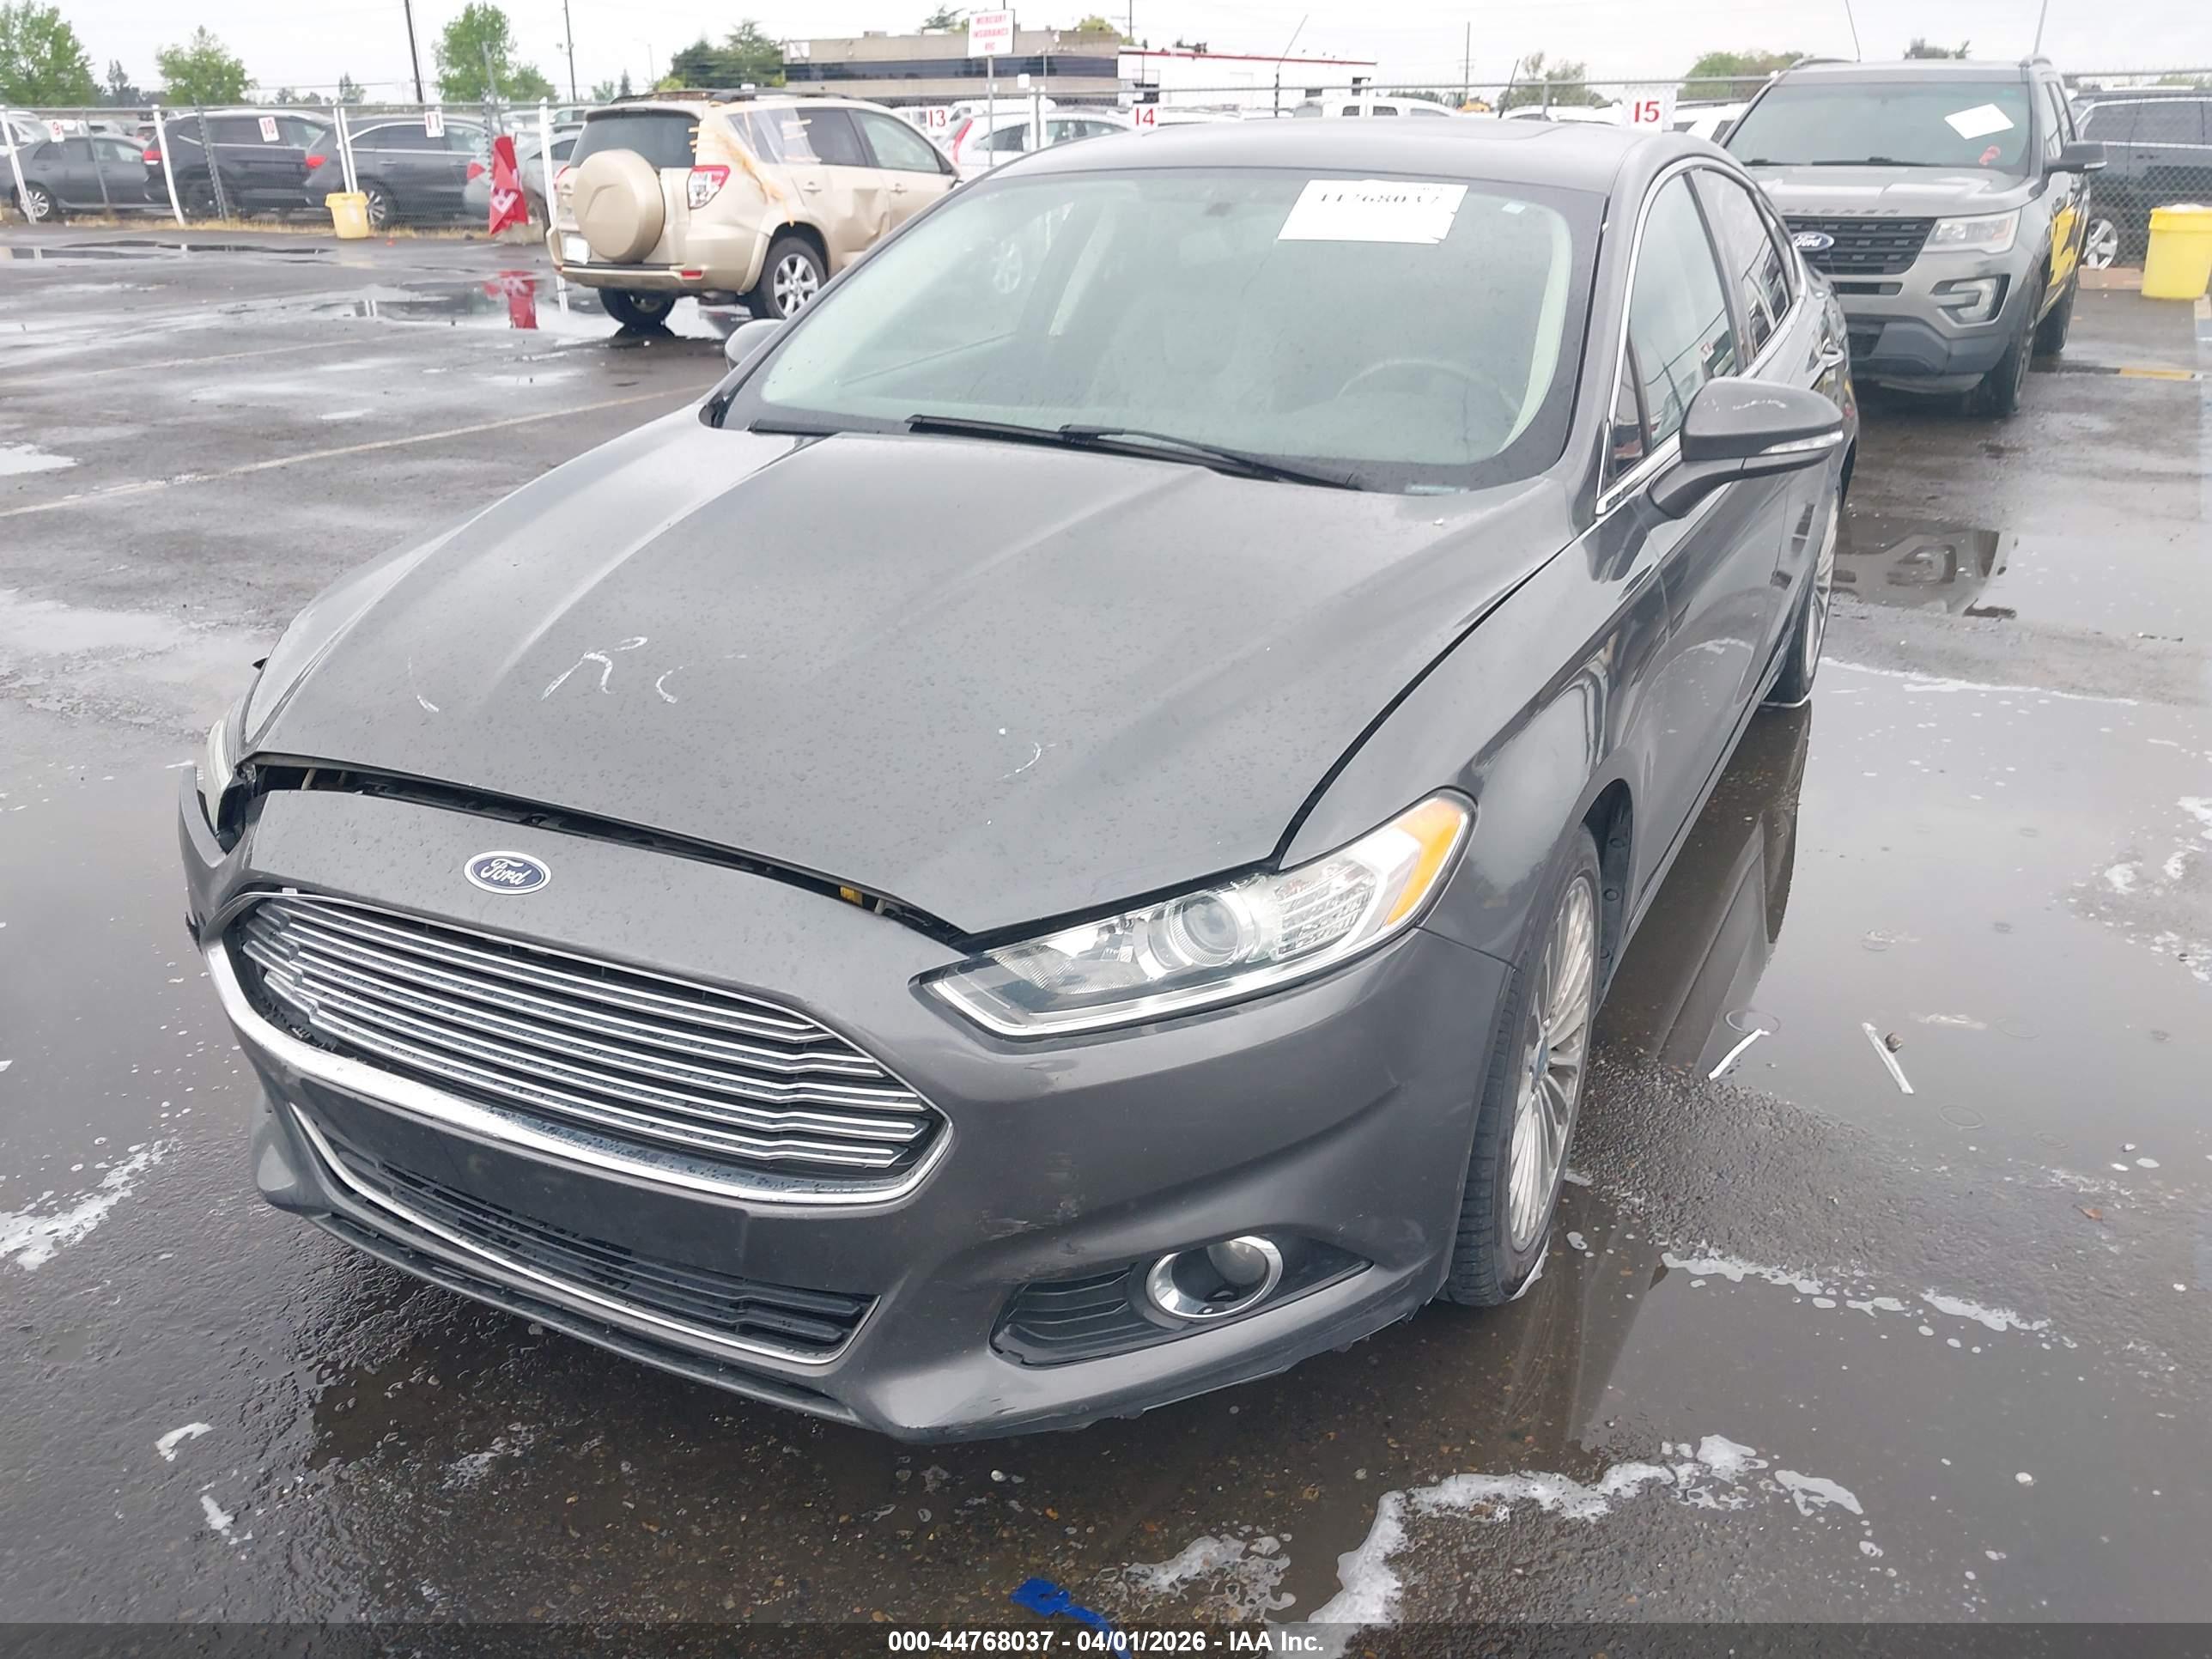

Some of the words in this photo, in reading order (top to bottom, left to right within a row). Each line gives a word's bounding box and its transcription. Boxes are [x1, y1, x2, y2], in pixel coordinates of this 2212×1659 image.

[973, 27, 1009, 39] INSURANCE
[929, 109, 946, 128] 13
[1136, 107, 1154, 126] 14
[1634, 101, 1660, 123] 15
[52, 121, 60, 135] 9
[263, 119, 276, 135] 10
[427, 114, 440, 130] 11
[1790, 233, 1822, 248] Ford
[480, 858, 532, 885] Ford
